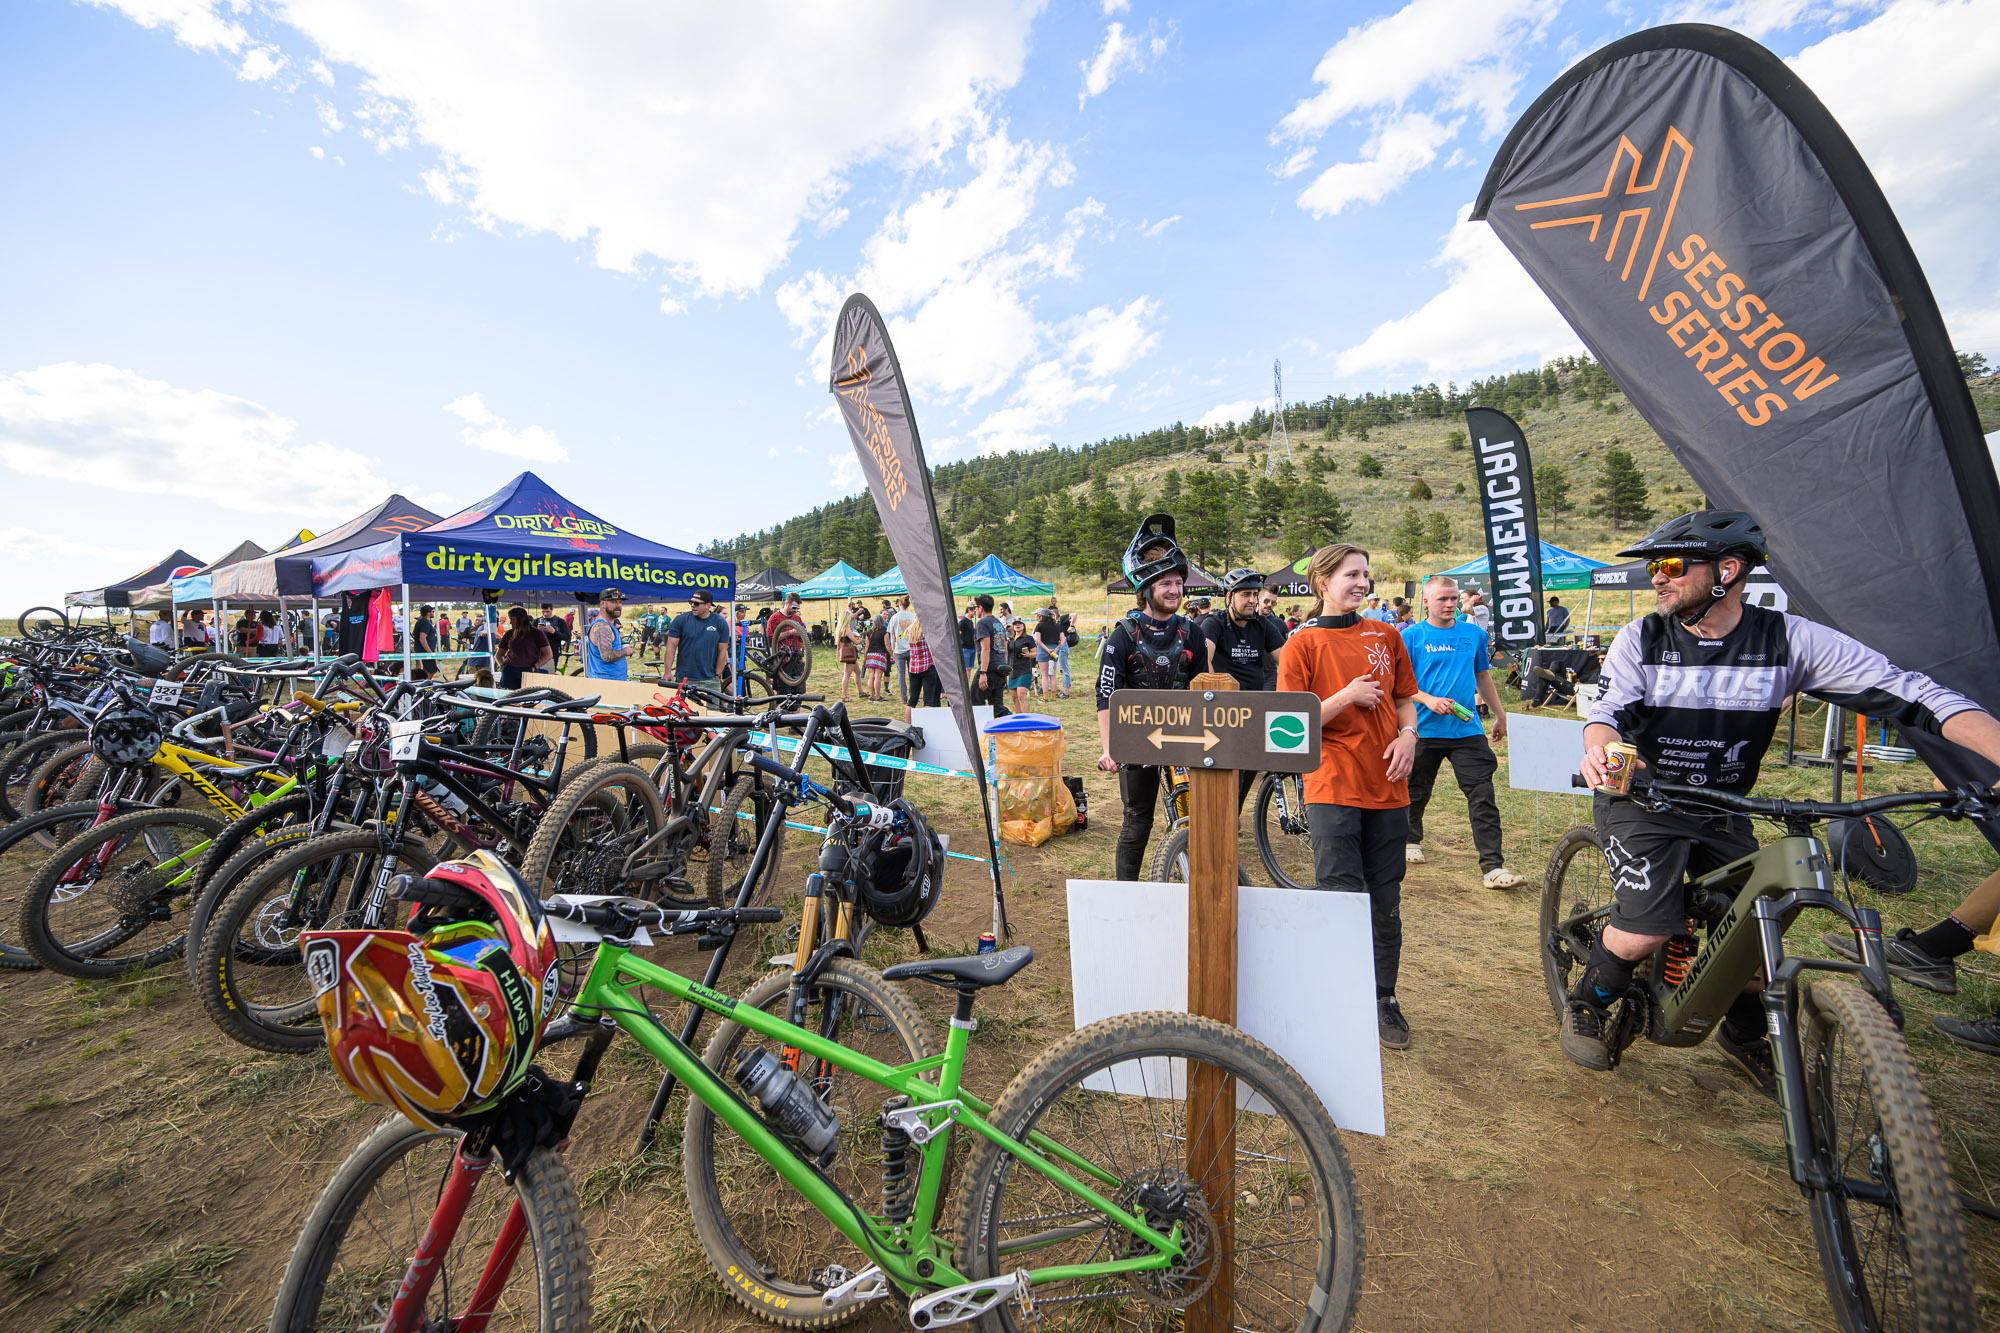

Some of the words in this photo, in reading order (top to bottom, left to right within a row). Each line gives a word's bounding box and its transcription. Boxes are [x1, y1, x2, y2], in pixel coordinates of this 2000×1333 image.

[1667, 234, 1840, 401] SESSION
[1649, 291, 1788, 427] SERIES
[867, 433, 902, 511] SERIES
[868, 403, 907, 496] SESSION
[494, 514, 554, 531] DIRTY
[561, 516, 618, 535] GIRLS
[426, 545, 729, 589] dirtygirlsathletics.com
[736, 583, 770, 592] SMITH
[154, 685, 178, 696] 324
[1652, 668, 1776, 700] BROS
[1706, 698, 1768, 708] SYNDICATE
[1118, 704, 1193, 726] MEADOW
[1203, 707, 1253, 728] LOOP
[1657, 737, 1693, 747] CUSH
[1694, 739, 1726, 748] CORE
[1657, 758, 1706, 769] SRAM
[180, 772, 244, 820] NORC
[365, 870, 392, 927] ZEB
[407, 943, 435, 995] Designs
[1672, 907, 1738, 1007] TRANSITION
[219, 956, 236, 1010] MAXXIS
[423, 993, 443, 1013] Lee
[500, 969, 530, 1037] SMITH
[993, 1096, 1044, 1178] MATELLO
[979, 1184, 996, 1243] Vittoria
[726, 1265, 791, 1310] MAXXIS
